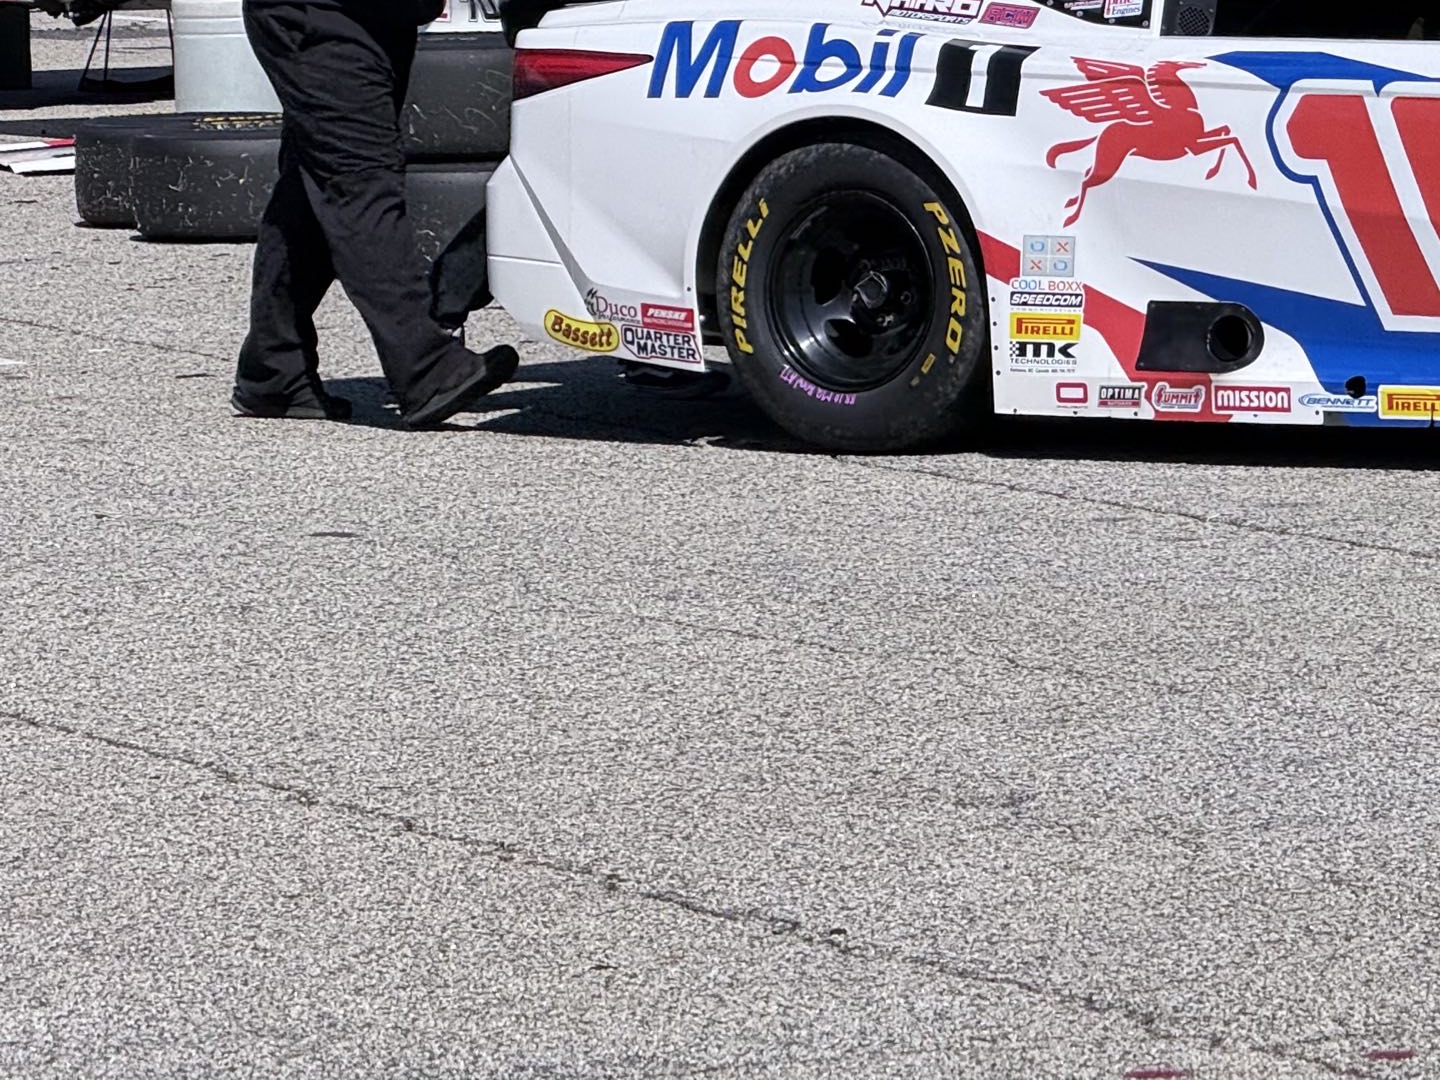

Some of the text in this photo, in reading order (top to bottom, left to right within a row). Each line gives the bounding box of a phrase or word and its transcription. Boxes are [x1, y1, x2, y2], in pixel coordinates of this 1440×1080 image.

[887, 8, 974, 26] MOTORSPORTS
[647, 19, 1004, 109] Mobil 1
[730, 197, 769, 355] PIRELLI
[1011, 279, 1083, 292] COOL BOXX
[595, 295, 638, 319] Duco
[1011, 293, 1082, 306] SPEEDCOM
[550, 314, 613, 348] Bassett
[1016, 317, 1076, 336] PIRELLI
[623, 327, 692, 347] QUARTER
[637, 340, 698, 361] MASTER
[1100, 387, 1140, 400] OPTIMA
[1156, 386, 1201, 406] SUMMIT
[1217, 389, 1289, 409] MISSION
[1307, 397, 1373, 407] BENNETT
